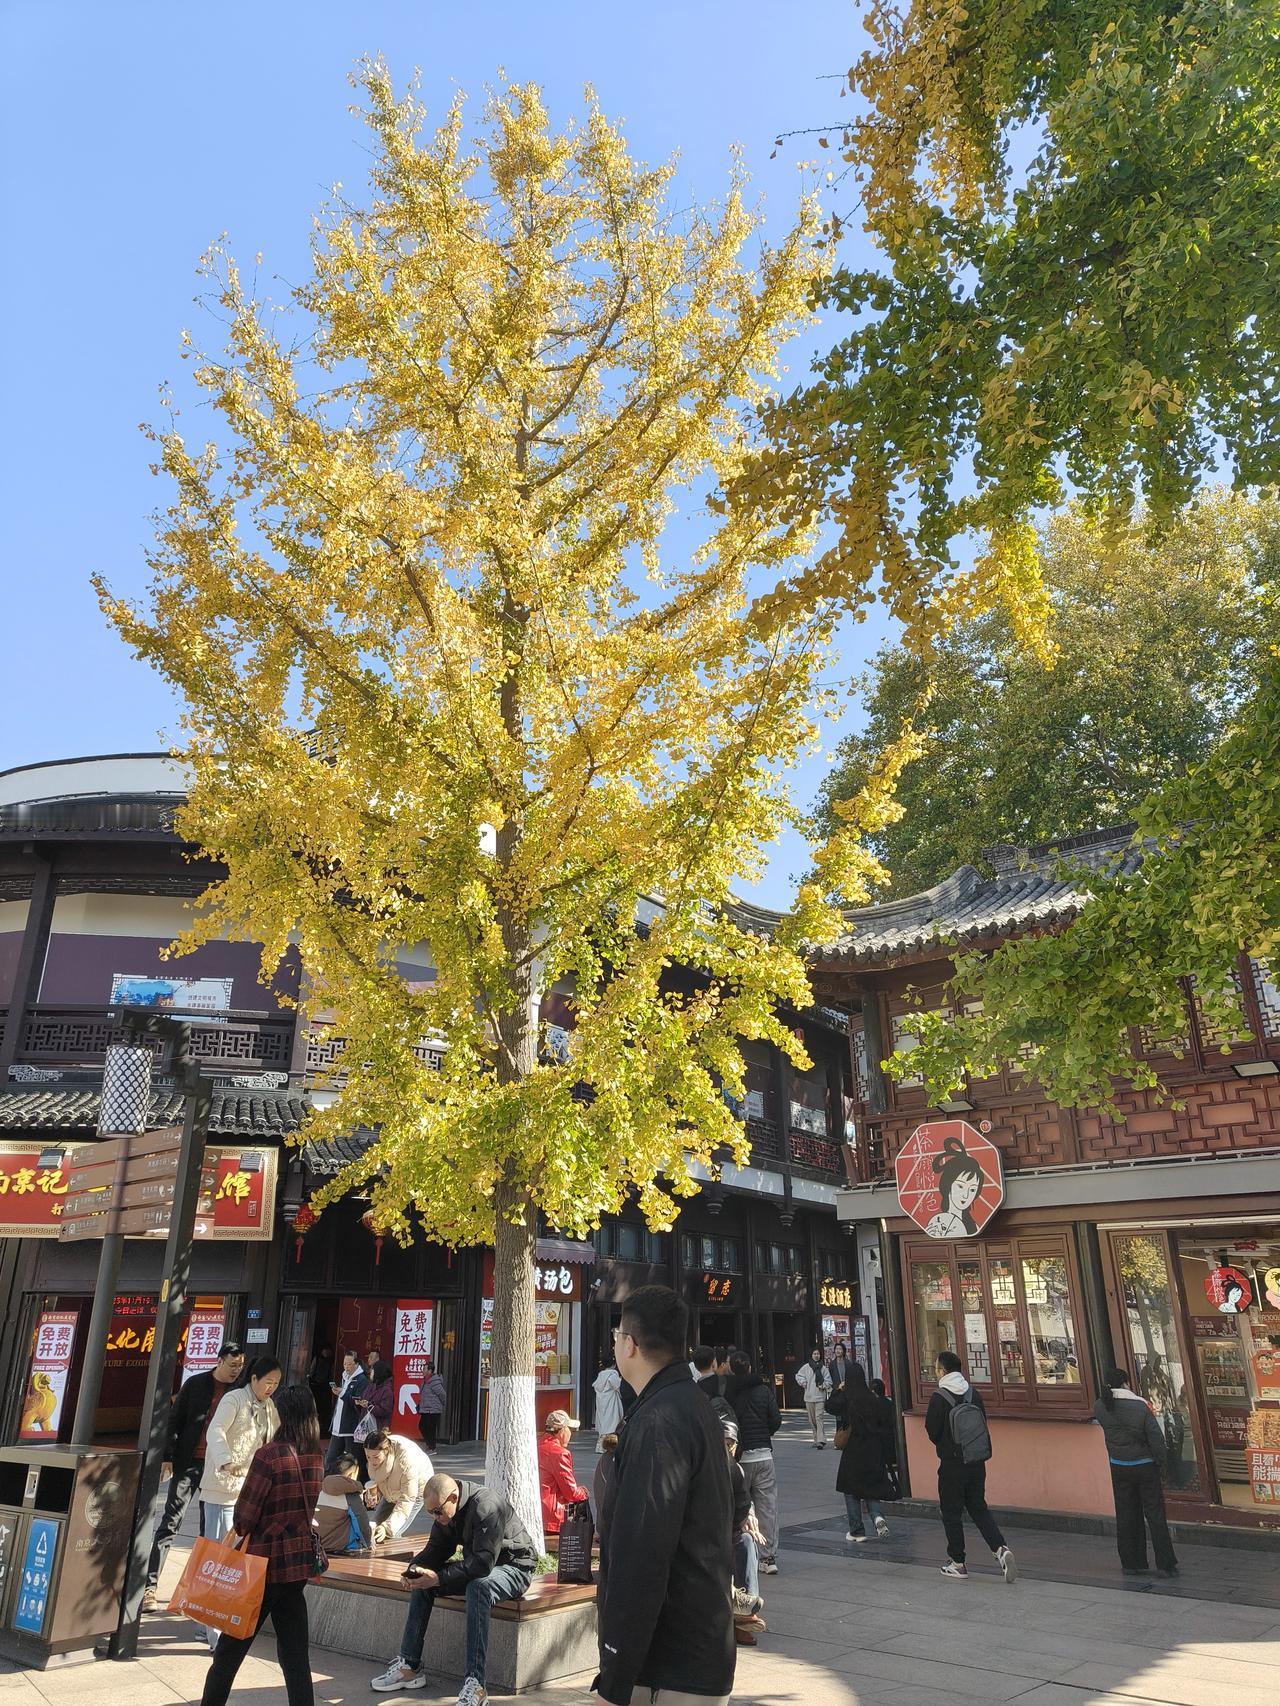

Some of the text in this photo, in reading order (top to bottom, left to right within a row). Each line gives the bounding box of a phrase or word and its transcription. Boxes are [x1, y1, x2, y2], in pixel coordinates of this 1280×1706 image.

[400, 1312, 427, 1332] 免费
[42, 1327, 71, 1341] 免费
[191, 1326, 220, 1340] 免费
[39, 1342, 69, 1356] 开放
[189, 1341, 218, 1355] 开放
[398, 1334, 427, 1353] 开放
